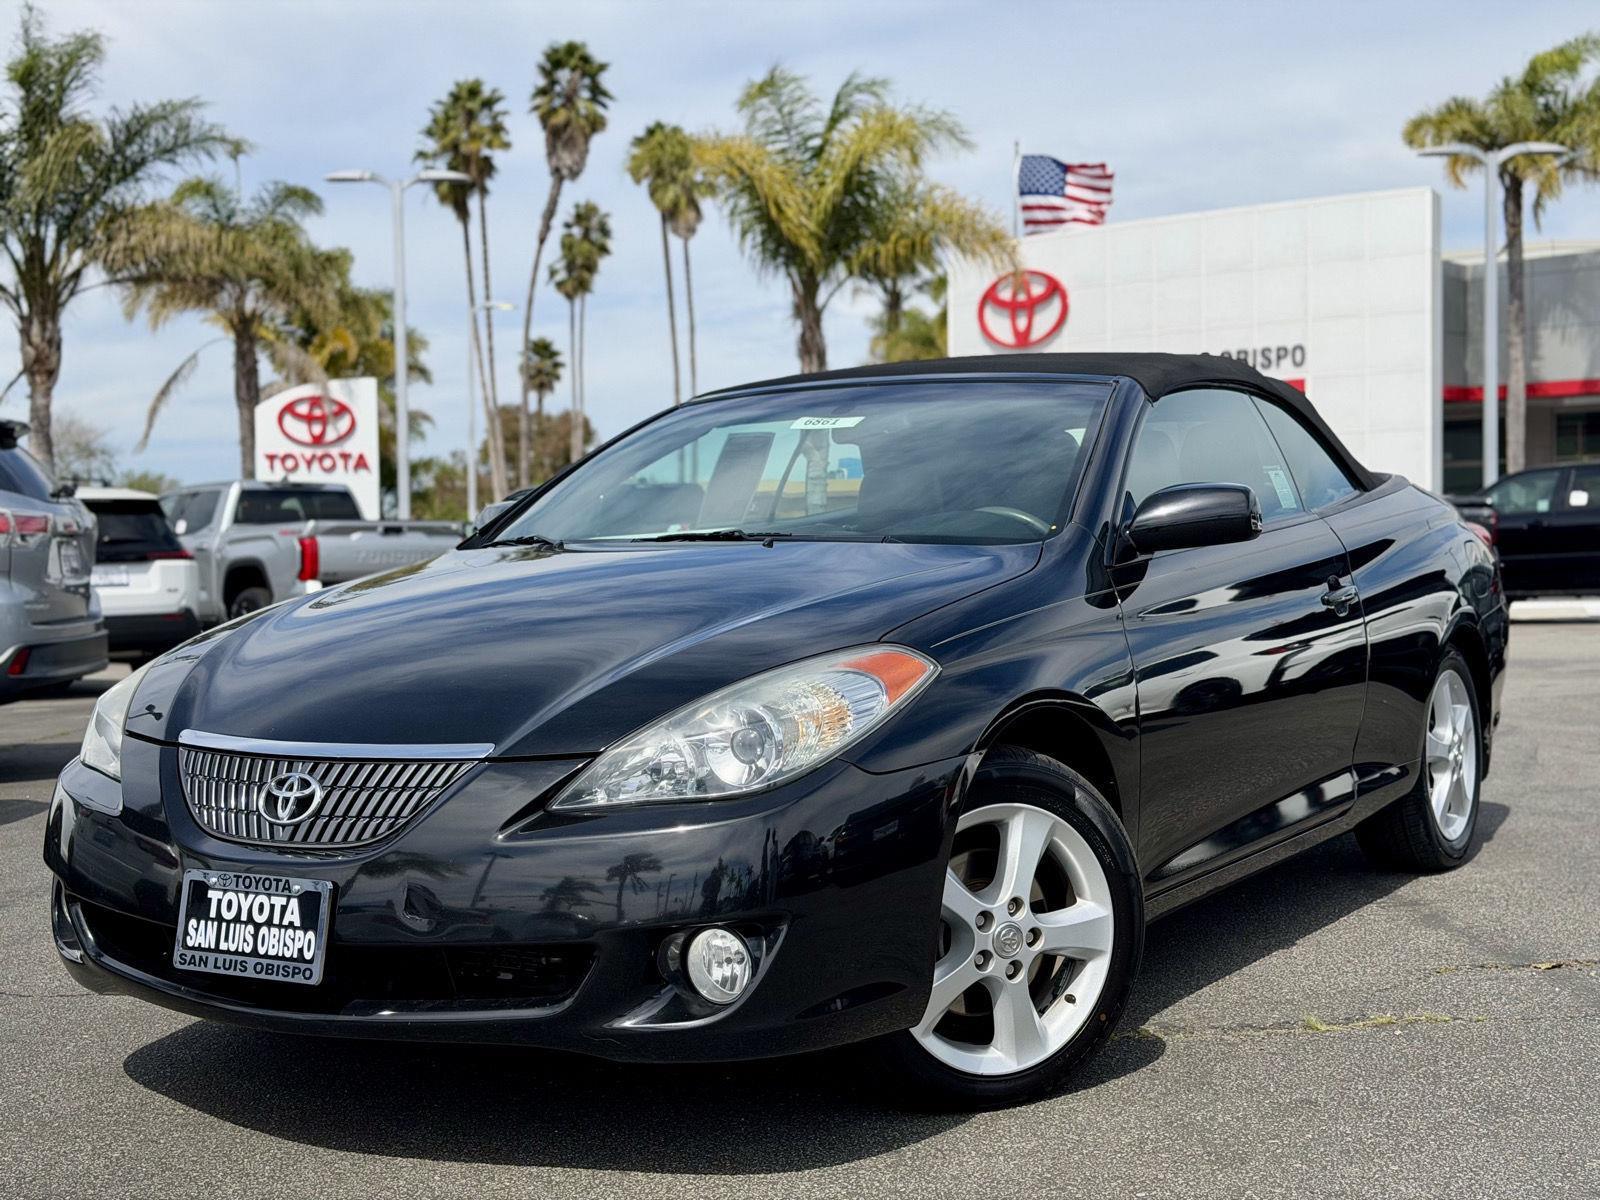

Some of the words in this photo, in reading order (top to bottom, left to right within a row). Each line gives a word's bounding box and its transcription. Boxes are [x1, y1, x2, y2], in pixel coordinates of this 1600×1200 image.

[265, 452, 371, 473] TOYOTA
[232, 874, 292, 894] TOYOTA
[207, 890, 301, 927] TOYOTA
[186, 919, 218, 950] SAN
[219, 922, 255, 954] LUIS
[257, 926, 316, 961] OBISPO
[178, 952, 209, 969] SAN
[213, 957, 248, 973] LUIS
[253, 961, 314, 981] OBISPO
